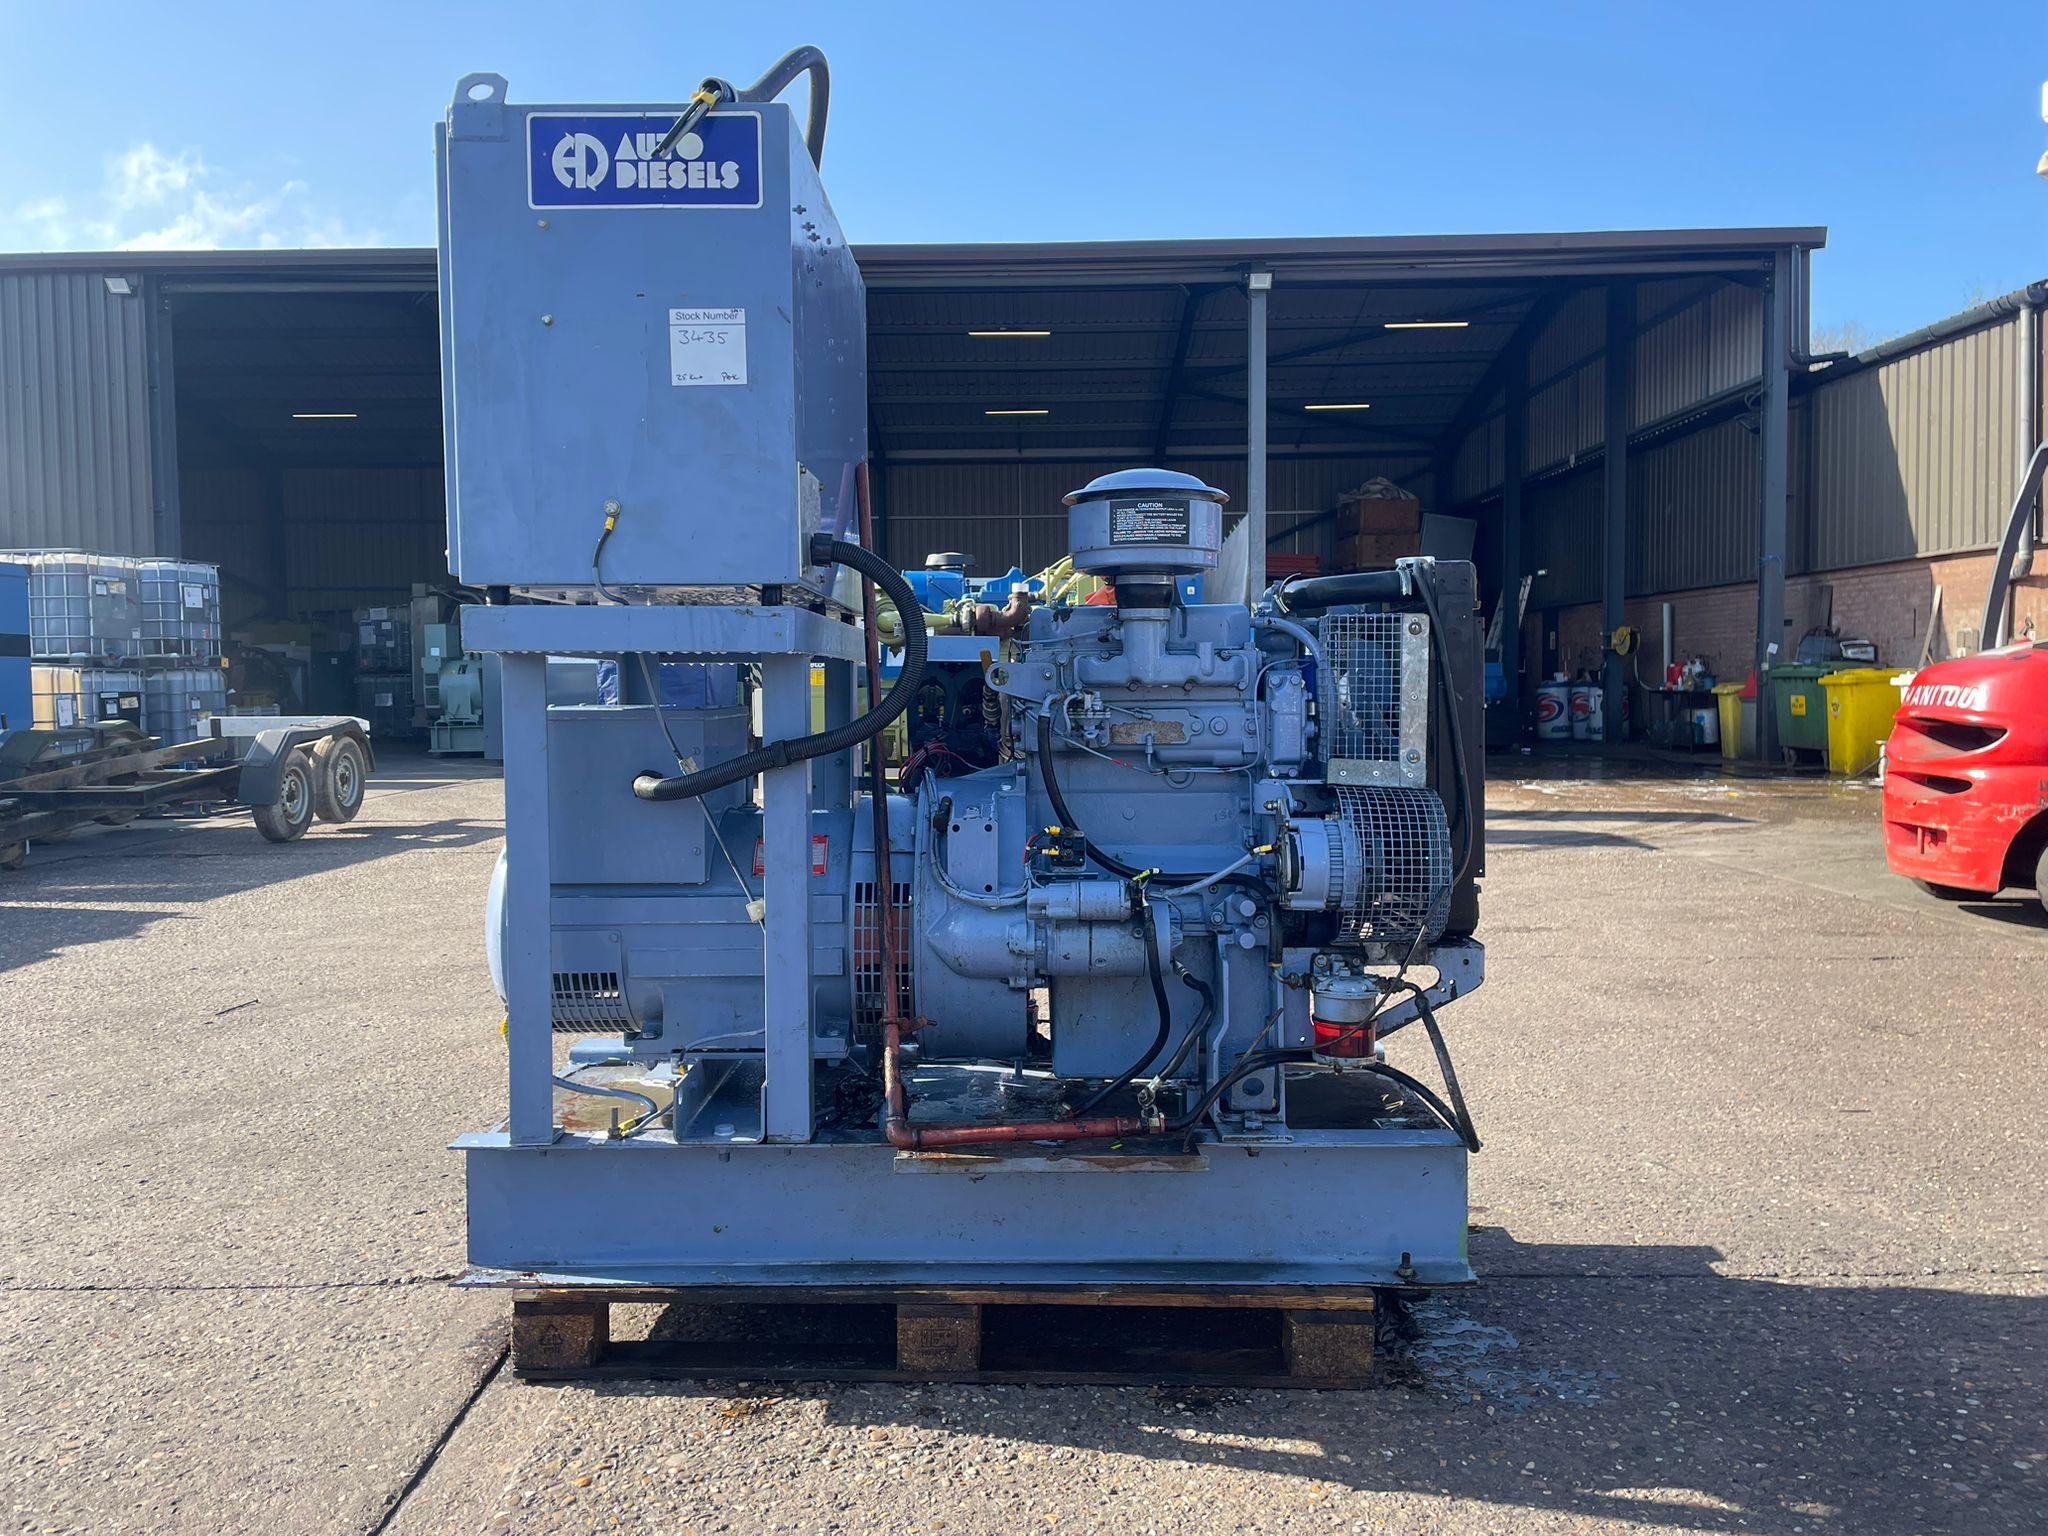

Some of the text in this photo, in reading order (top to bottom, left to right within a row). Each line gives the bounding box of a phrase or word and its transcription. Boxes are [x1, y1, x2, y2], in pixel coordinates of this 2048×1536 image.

[616, 161, 740, 190] DIESELS
[675, 311, 739, 321] Stock Number
[678, 329, 729, 345] 3435
[1900, 684, 1979, 709] MANITOU
